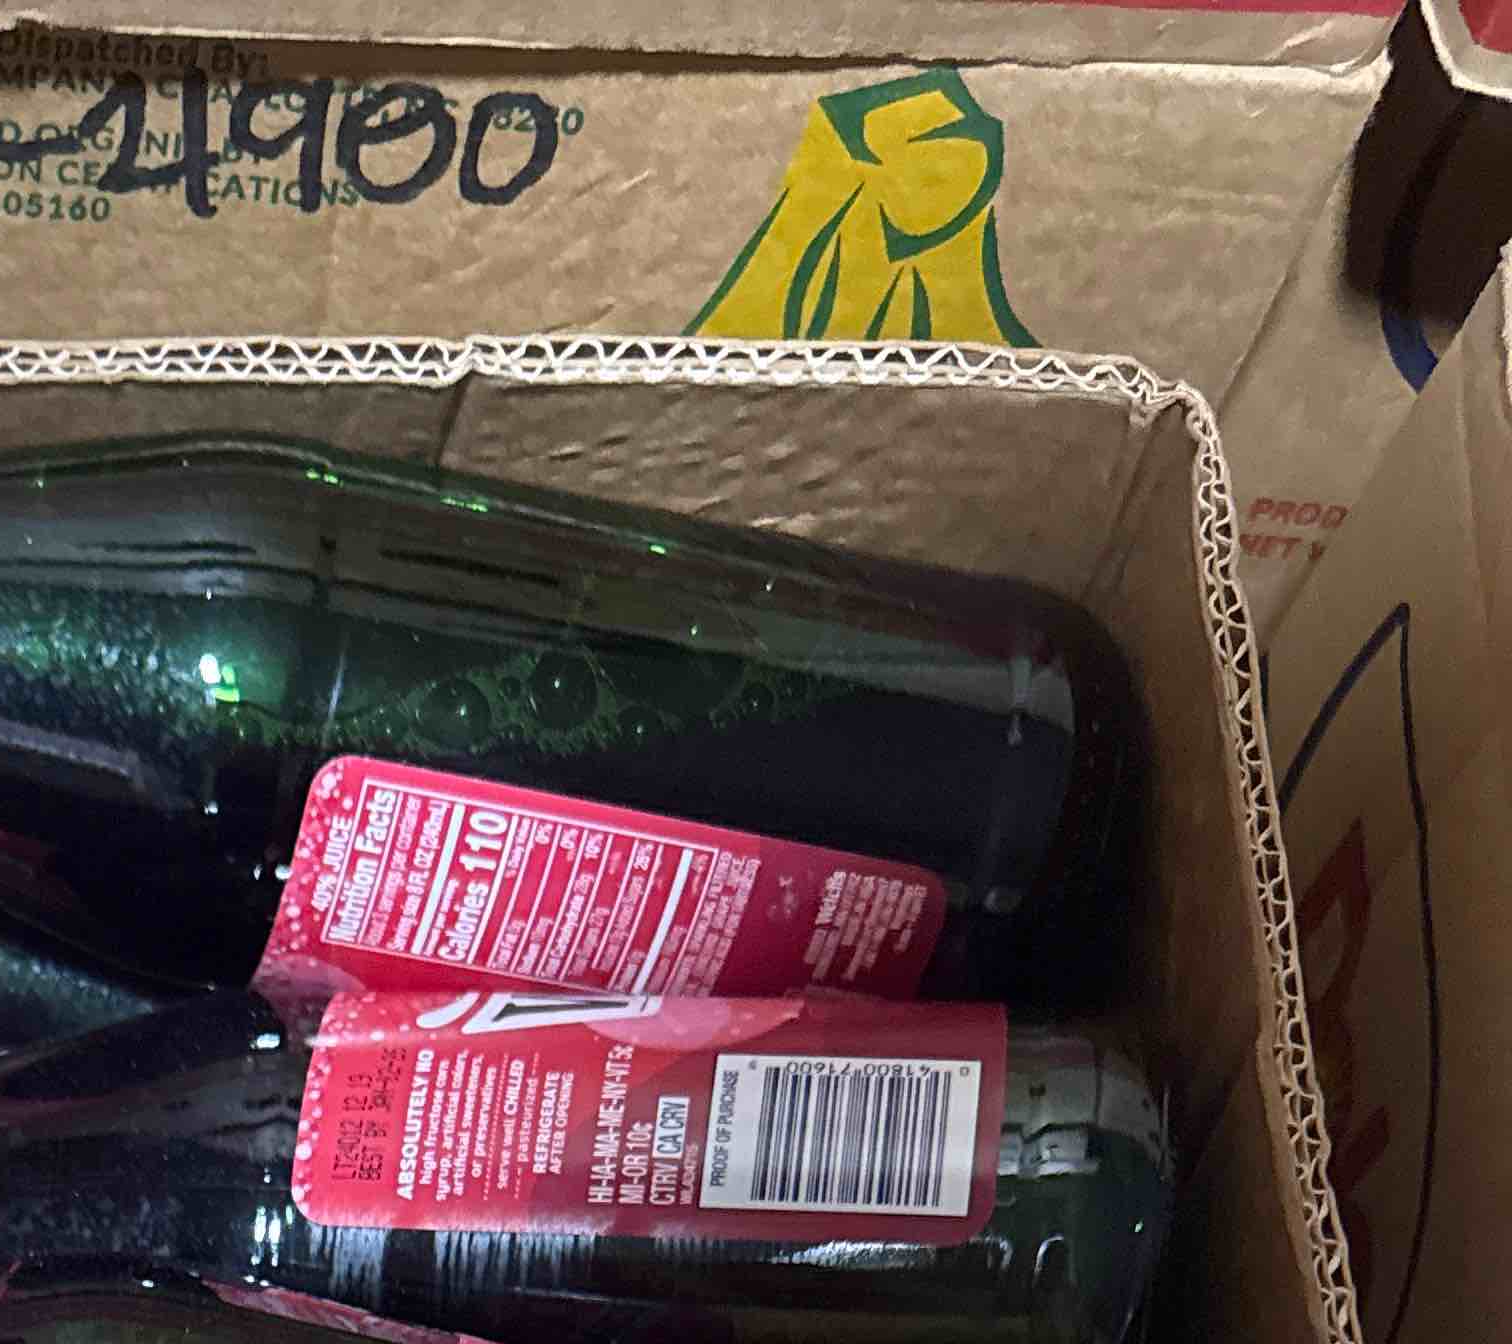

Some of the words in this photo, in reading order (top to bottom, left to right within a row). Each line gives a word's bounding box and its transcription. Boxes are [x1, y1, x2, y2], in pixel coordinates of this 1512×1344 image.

[321, 815, 352, 871] JUICE
[328, 856, 378, 942] Nutrition
[353, 787, 395, 854] Facts
[458, 810, 509, 875] 110
[436, 879, 488, 961] Calories
[502, 1059, 524, 1115] CHILLED
[554, 1070, 574, 1127] OPENING
[659, 1099, 686, 1130] CRV
[717, 1069, 738, 1125] PURCHASE
[395, 1075, 430, 1200] ABSOLUTELY
[414, 1048, 434, 1073] NO
[532, 1070, 559, 1173] REFRIGERATE
[656, 1133, 682, 1156] CA
[715, 1126, 731, 1143] OF
[418, 1150, 438, 1185] high
[548, 1129, 566, 1174] AFTER
[618, 1152, 649, 1205] MI-OR
[709, 1144, 729, 1187] PROOF
[649, 1160, 679, 1206] CTRV
